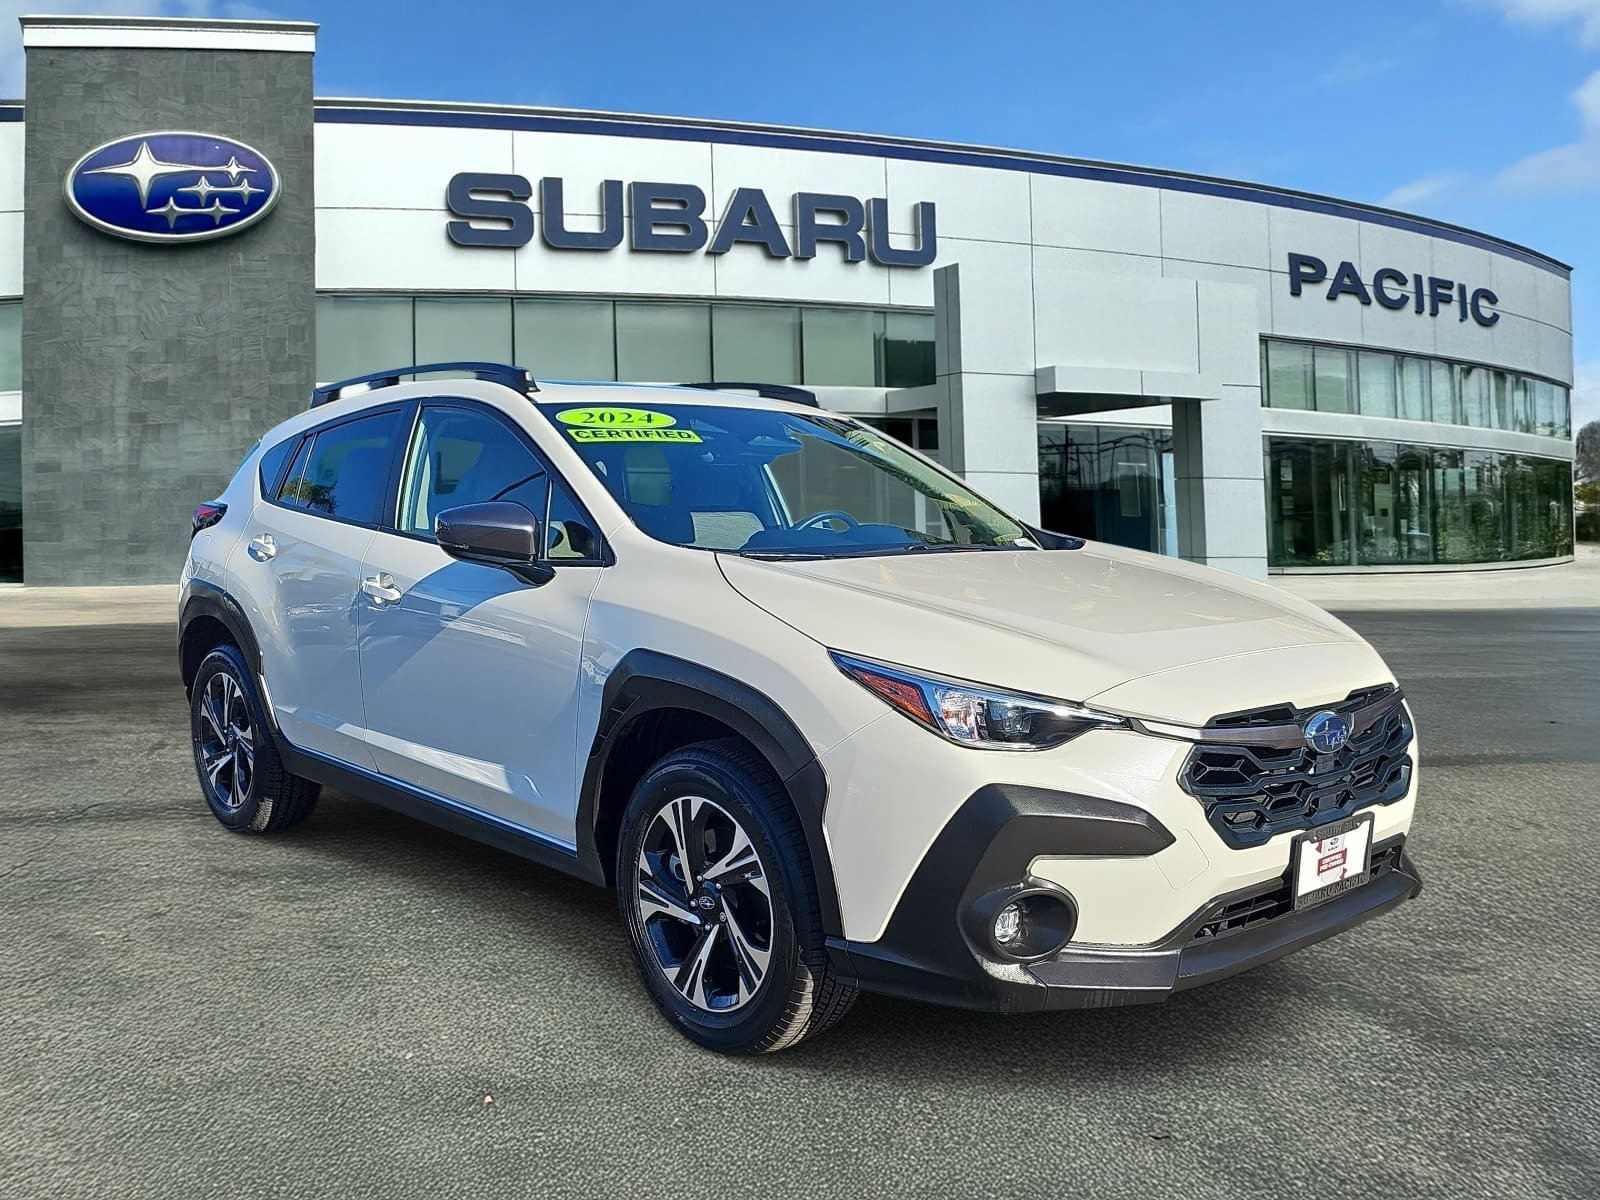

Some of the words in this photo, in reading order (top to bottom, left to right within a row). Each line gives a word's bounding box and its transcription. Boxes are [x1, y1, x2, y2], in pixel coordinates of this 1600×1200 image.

[446, 171, 938, 268] SUBARU
[1287, 252, 1500, 327] PACIFIC
[575, 429, 693, 440] CERTIFIED
[580, 411, 654, 424] 2024
